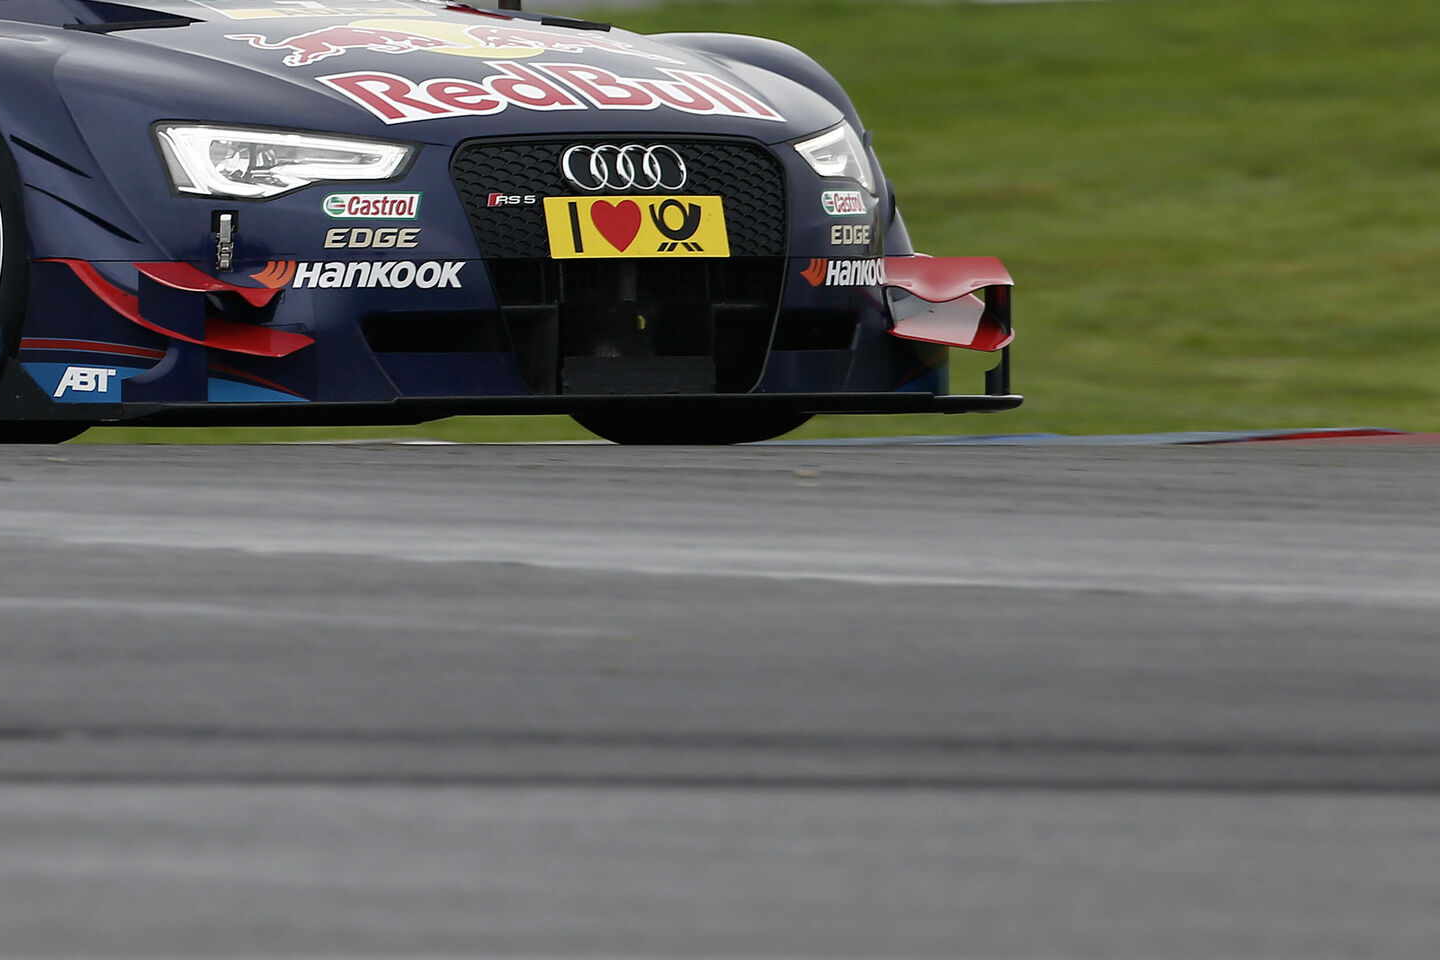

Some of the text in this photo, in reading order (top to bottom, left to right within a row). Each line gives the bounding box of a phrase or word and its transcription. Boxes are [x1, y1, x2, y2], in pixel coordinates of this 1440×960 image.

[315, 60, 787, 126] Red Bull
[347, 196, 414, 216] Castrol
[496, 194, 537, 205] RS 5
[568, 201, 584, 254] I
[831, 225, 871, 244] EDGE
[323, 228, 421, 248] EDGE
[53, 366, 117, 398] ABT
